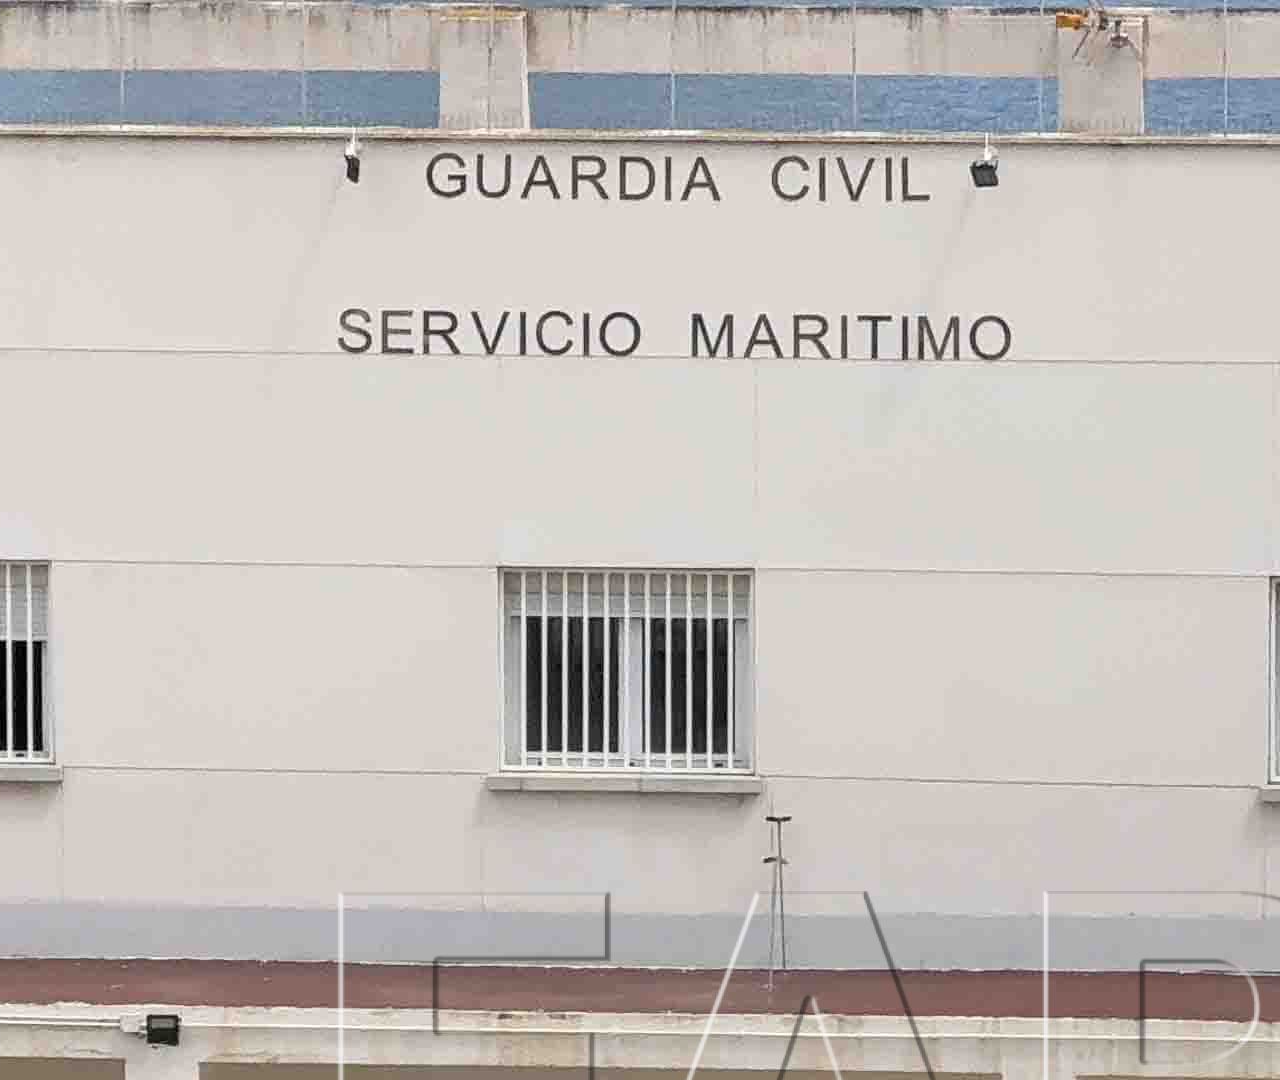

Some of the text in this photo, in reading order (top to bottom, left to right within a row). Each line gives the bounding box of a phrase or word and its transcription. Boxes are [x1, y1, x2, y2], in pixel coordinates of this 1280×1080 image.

[425, 153, 931, 201] GUARDIA CIVIL
[336, 308, 1013, 361] SERVICIO MARITIMO
